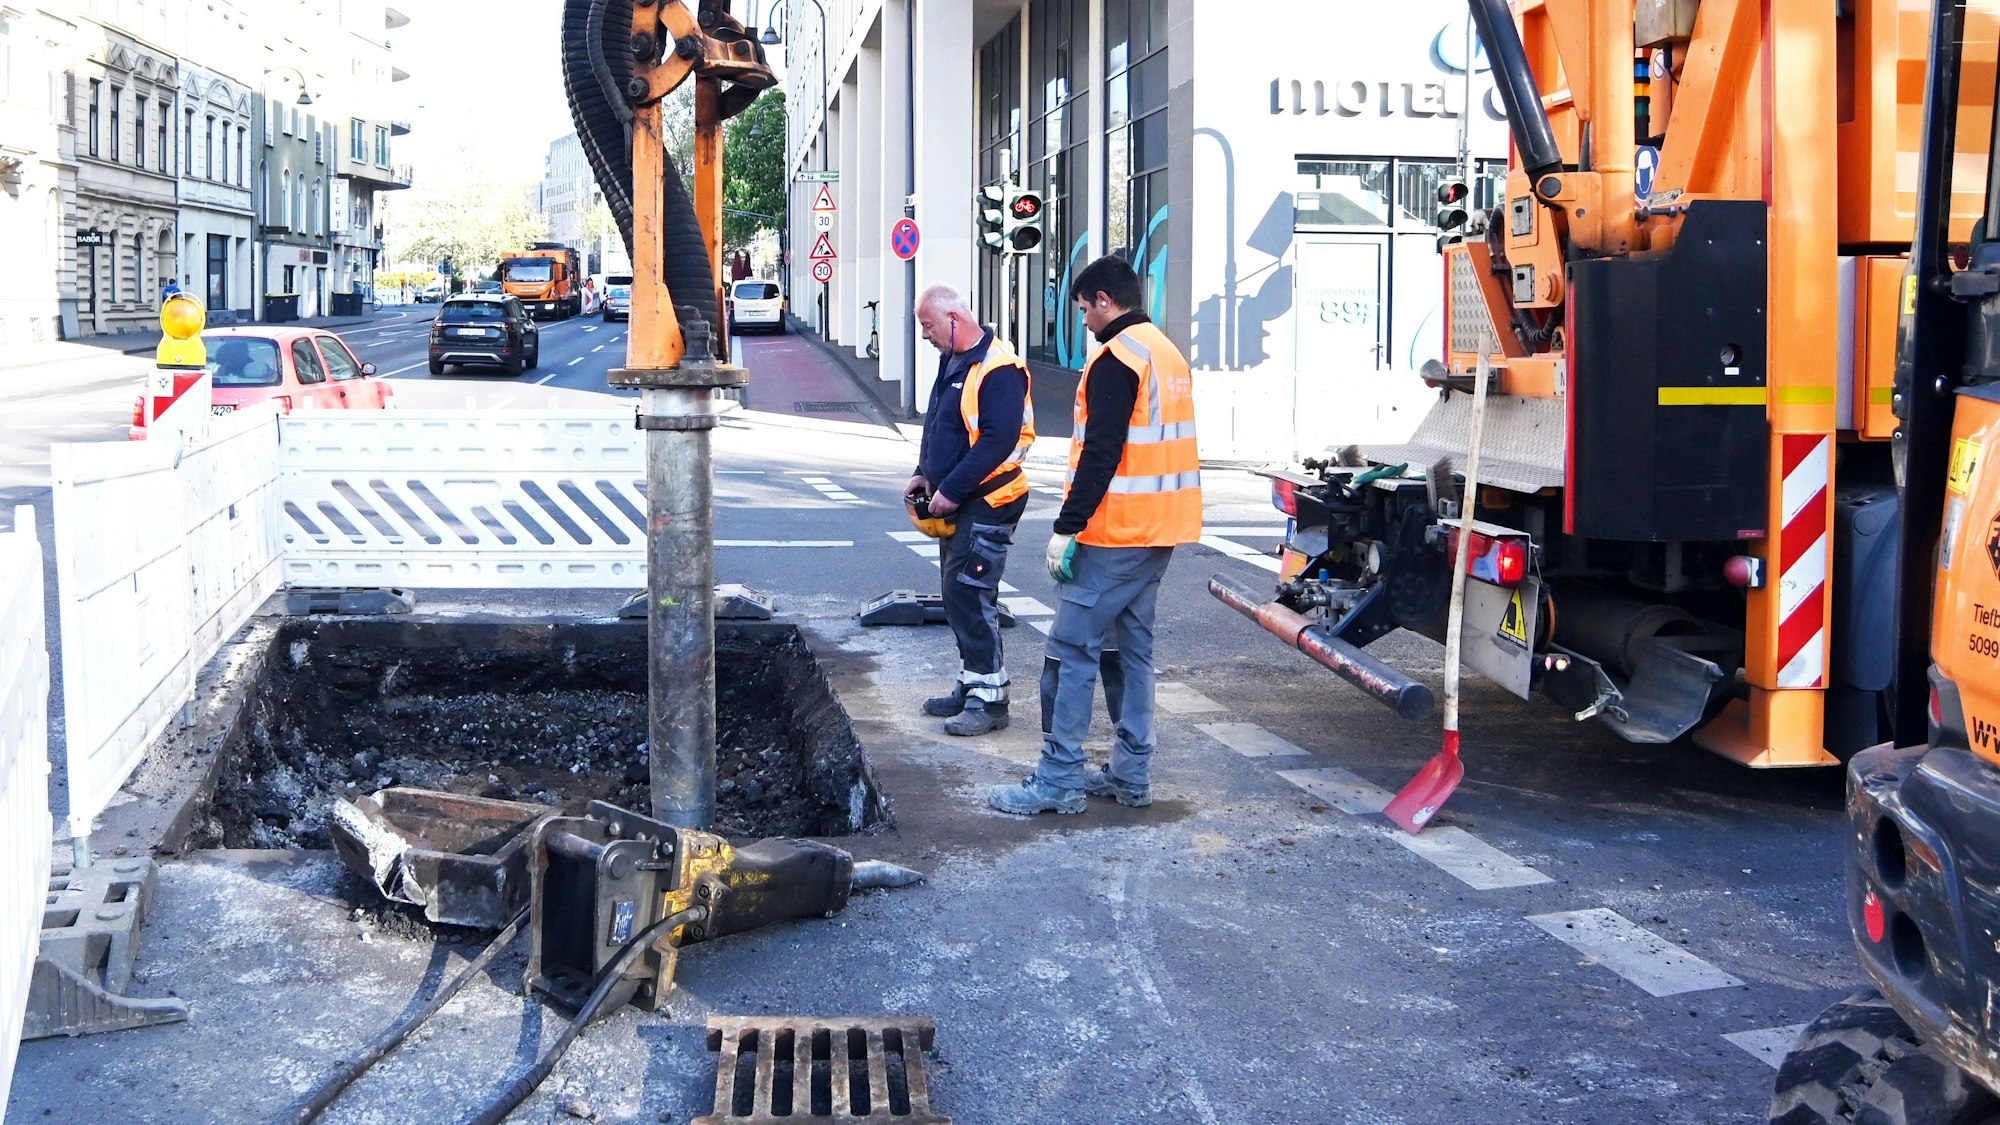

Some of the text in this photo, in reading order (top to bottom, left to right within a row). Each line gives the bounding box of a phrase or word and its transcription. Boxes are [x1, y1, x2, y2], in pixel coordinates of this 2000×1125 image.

[1269, 77, 1464, 118] MOTEL
[818, 216, 830, 226] 30
[816, 266, 829, 276] 30
[1969, 633, 2000, 659] 5099
